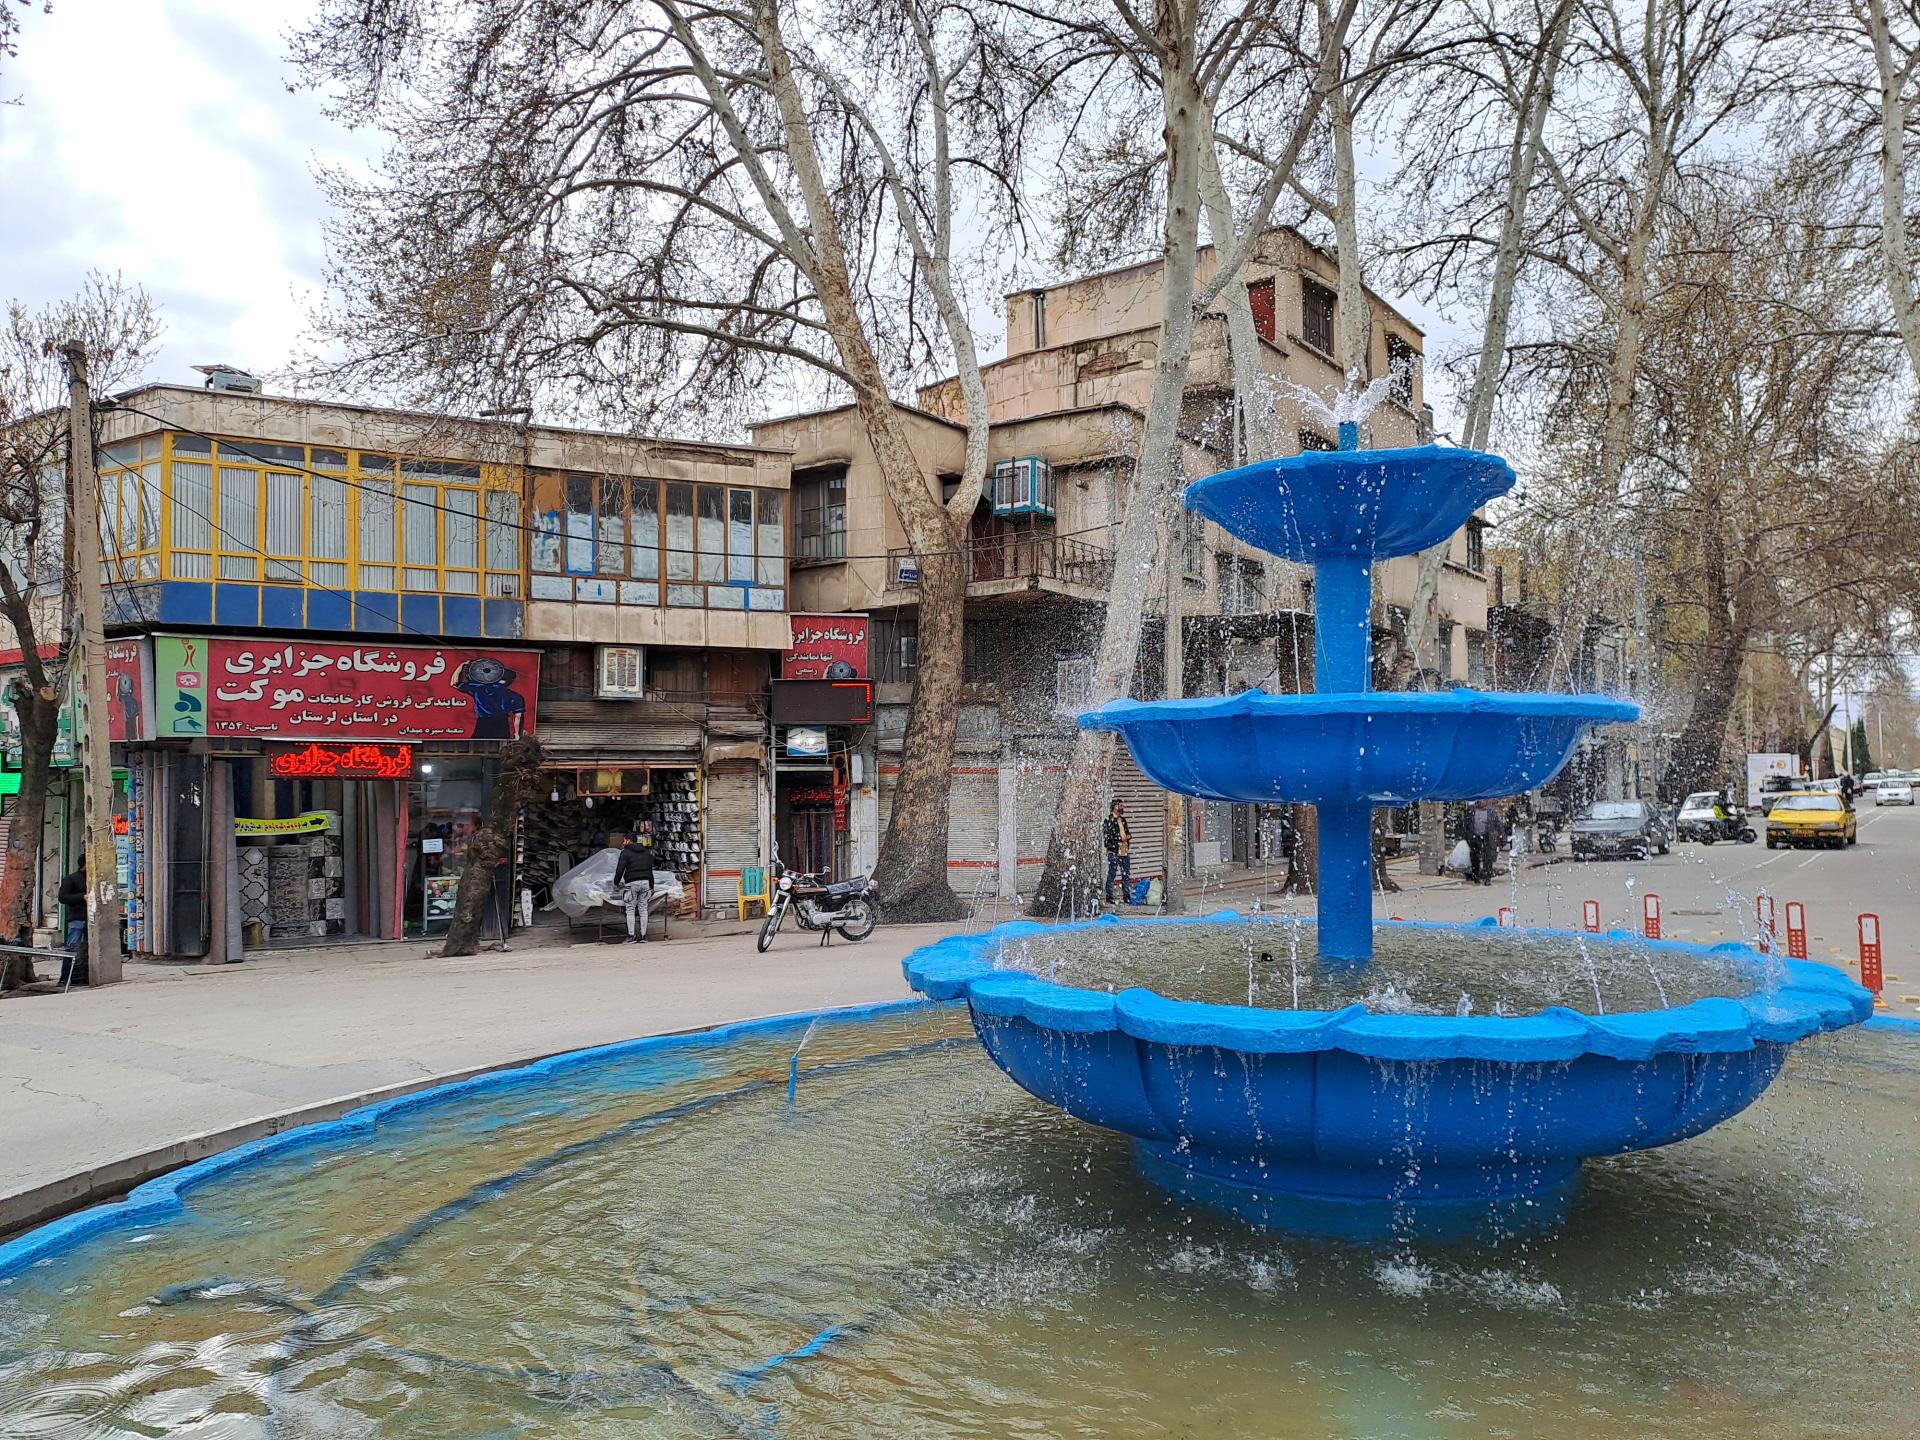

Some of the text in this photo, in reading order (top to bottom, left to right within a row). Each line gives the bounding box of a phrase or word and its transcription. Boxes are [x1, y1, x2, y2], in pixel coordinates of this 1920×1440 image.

[823, 626, 864, 645] فروشگاه
[108, 643, 137, 663] فروشگاه
[820, 653, 833, 661] تنها
[225, 645, 446, 682] فروشگاه جزایری
[216, 678, 305, 710] موکت
[376, 695, 412, 709] فروش
[414, 696, 467, 709] نمایندگی
[289, 709, 398, 726] در استان لرستان
[340, 744, 408, 776] فروشگاه
